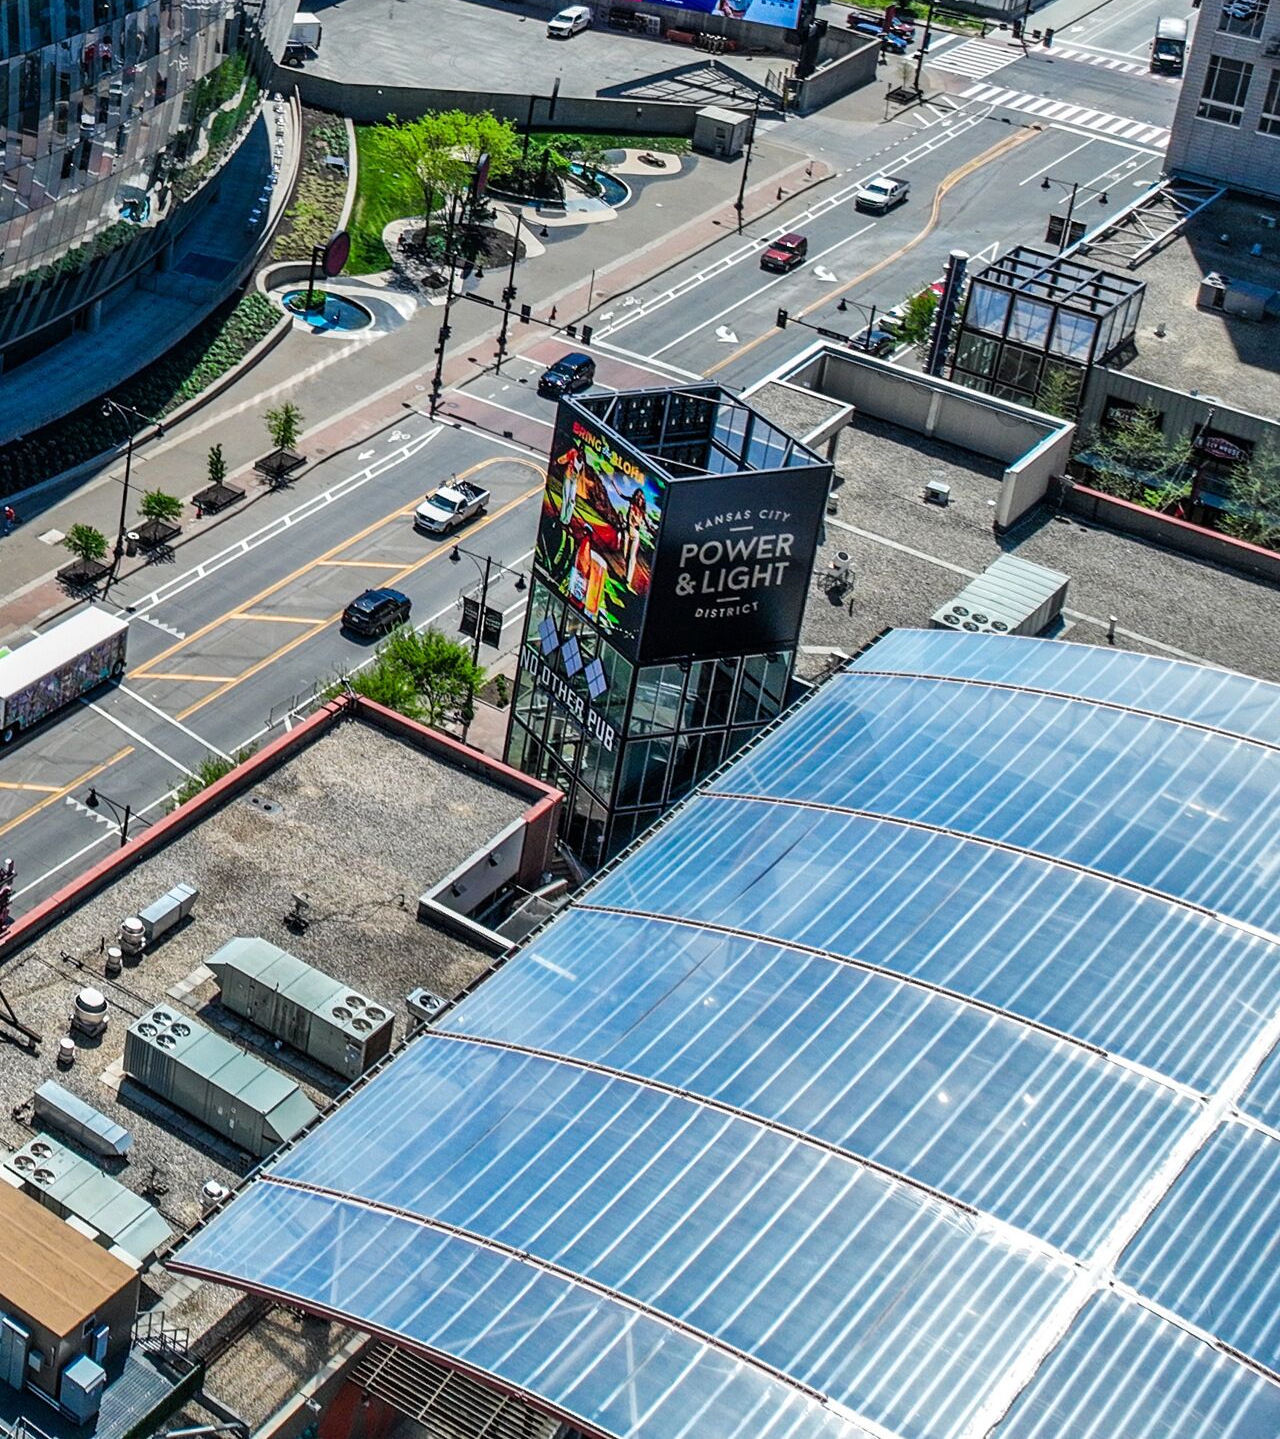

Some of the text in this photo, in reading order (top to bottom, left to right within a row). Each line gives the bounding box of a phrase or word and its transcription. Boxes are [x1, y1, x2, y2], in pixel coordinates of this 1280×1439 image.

[572, 421, 602, 451] BRING
[609, 450, 646, 485] ALOHA
[694, 509, 791, 533] KANSAS CITY
[680, 533, 795, 568] POWER
[675, 562, 790, 596] & LIGHT
[694, 601, 759, 618] DISTRICT
[520, 644, 615, 752] NO OTHER PUB
